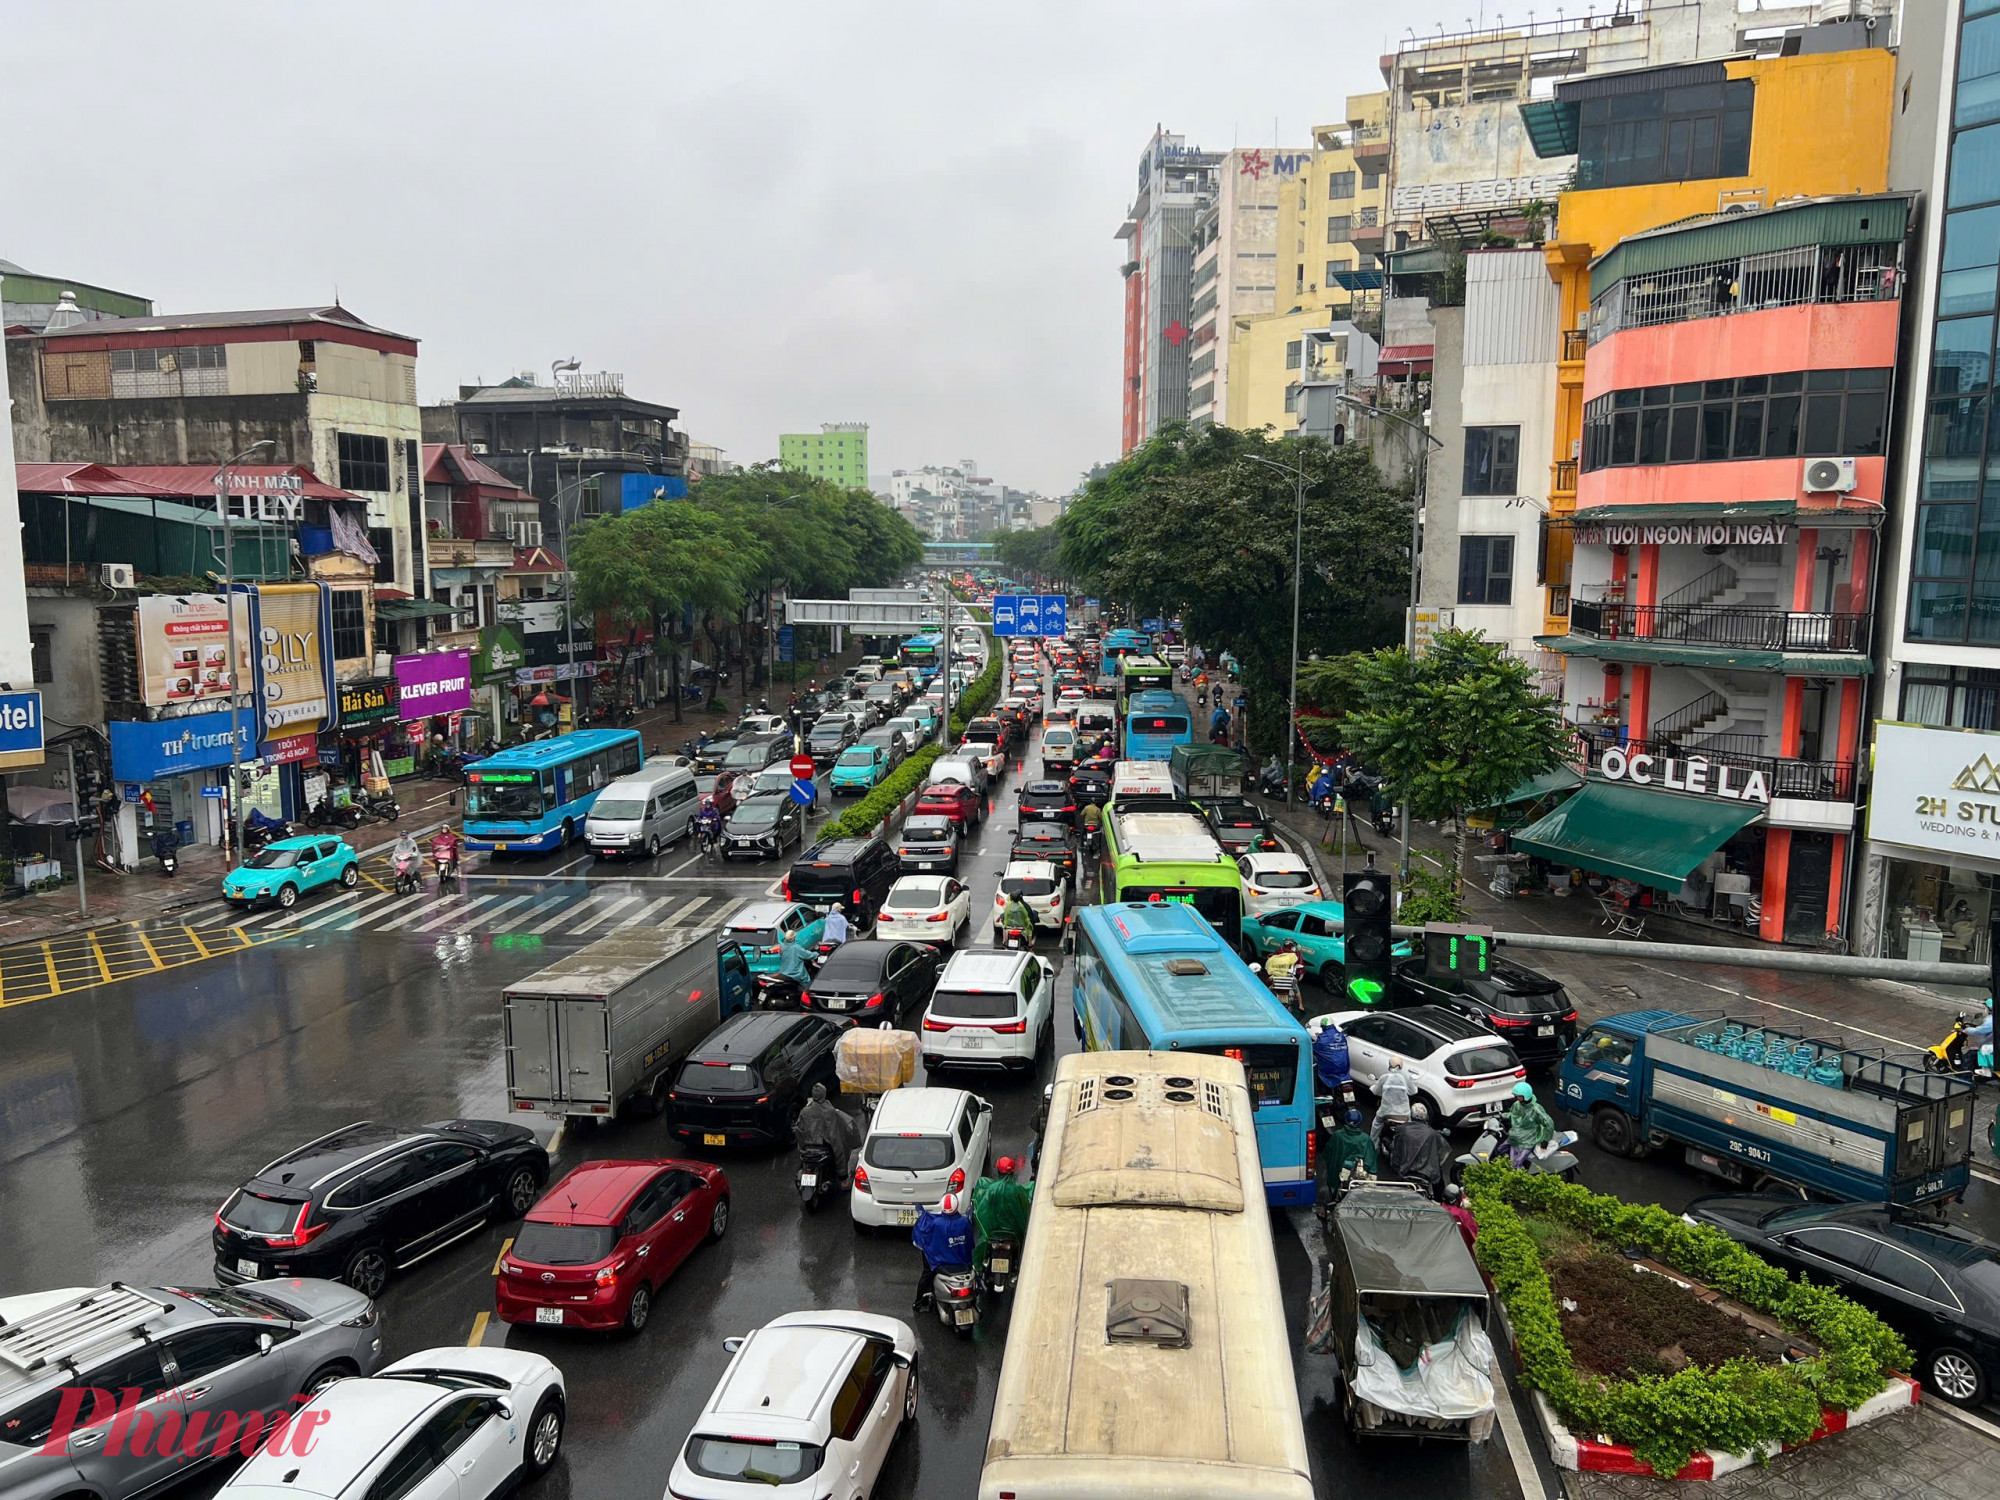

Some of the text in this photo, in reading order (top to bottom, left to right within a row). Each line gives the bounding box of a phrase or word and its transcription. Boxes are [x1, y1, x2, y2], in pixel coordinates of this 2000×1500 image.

[215, 494, 302, 521] LILY
[1643, 525, 1692, 545] NGON
[401, 677, 466, 700] KLEVER FRUIT
[342, 692, 362, 712] Hải
[364, 689, 385, 708] Sản
[0, 700, 35, 730] tel
[162, 740, 184, 756] TH
[265, 752, 286, 763] TRONG
[1600, 740, 1769, 804] ỐC LÊ LA
[1915, 795, 1947, 818] 2H
[1920, 820, 1990, 840] WEDDING &
[1450, 935, 1487, 972] 17
[1729, 1140, 1743, 1153] 29C
[902, 1209, 914, 1217] 99A
[543, 1308, 556, 1316] 99A
